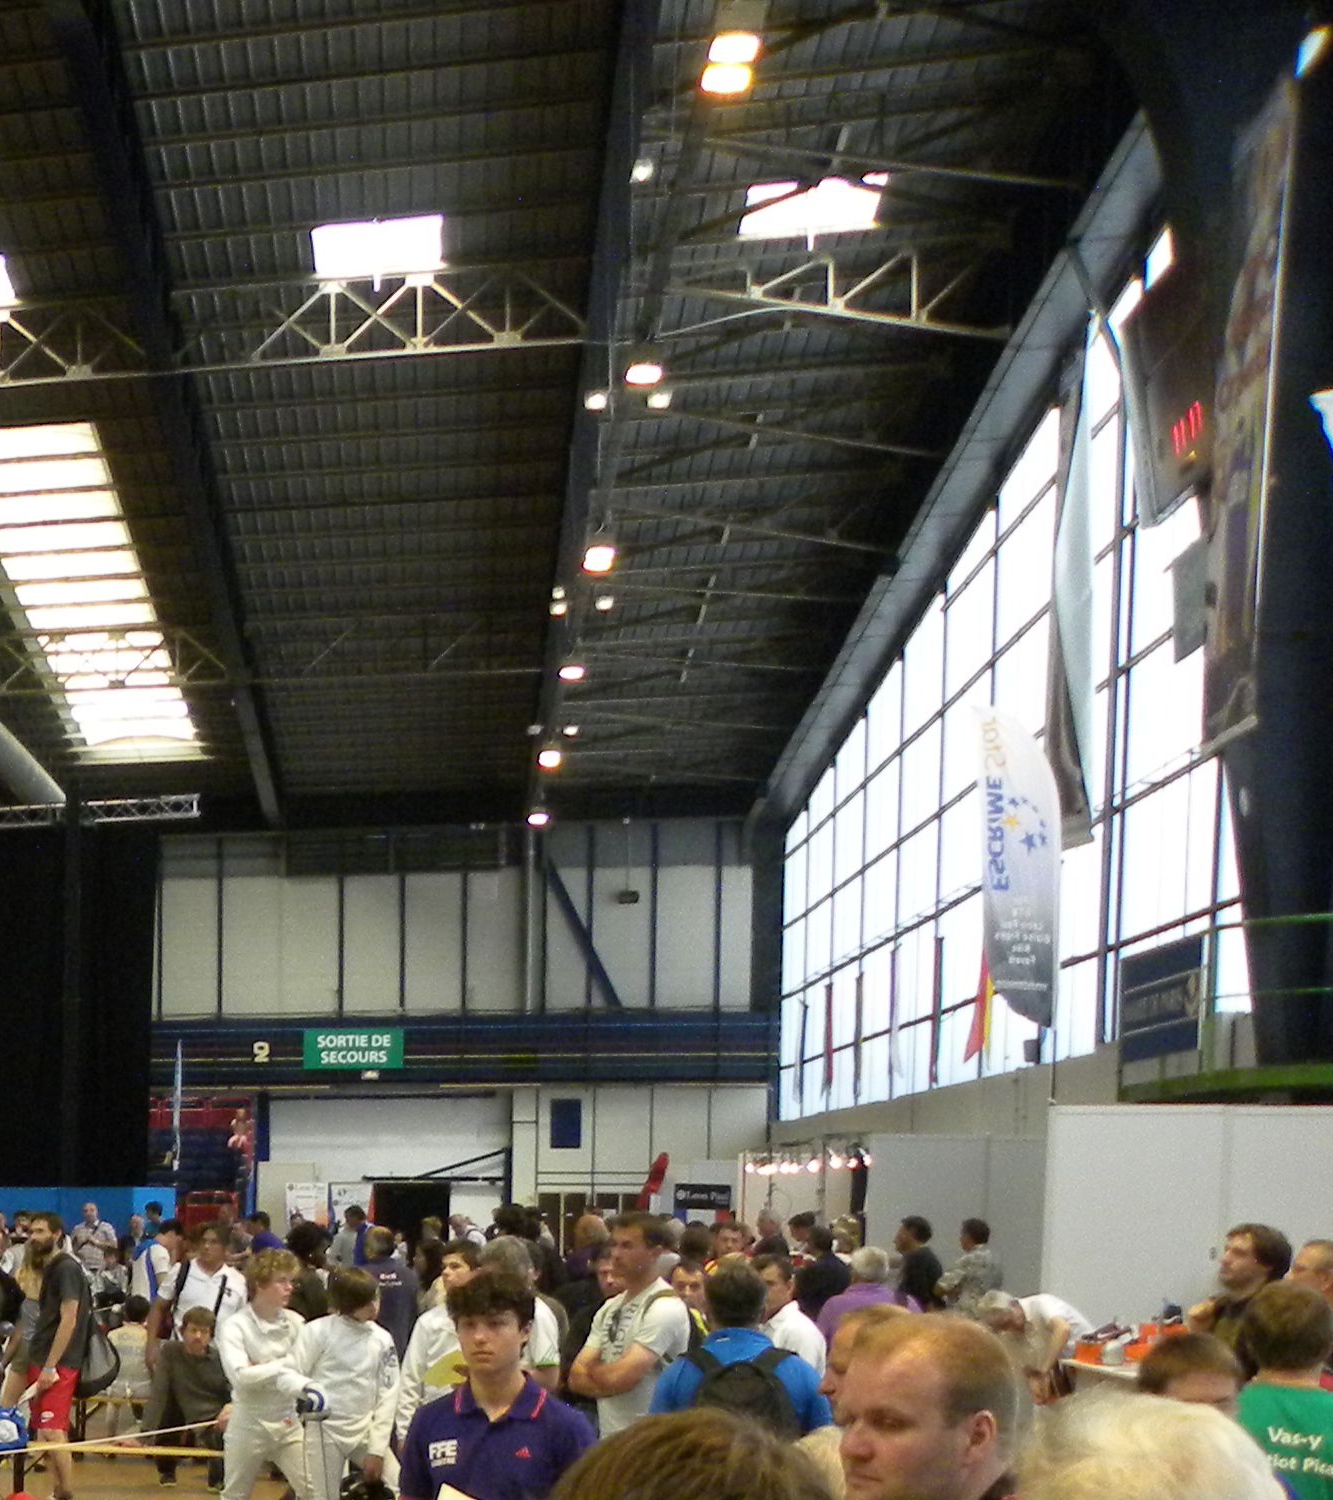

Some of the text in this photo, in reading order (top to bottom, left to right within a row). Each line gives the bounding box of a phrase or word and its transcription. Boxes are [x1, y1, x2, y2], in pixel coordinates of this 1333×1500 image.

[317, 1034, 391, 1048] SORTIE DE
[253, 1041, 270, 1062] 2
[320, 1050, 388, 1064] SECOURS
[1267, 1425, 1322, 1451] Vas-y
